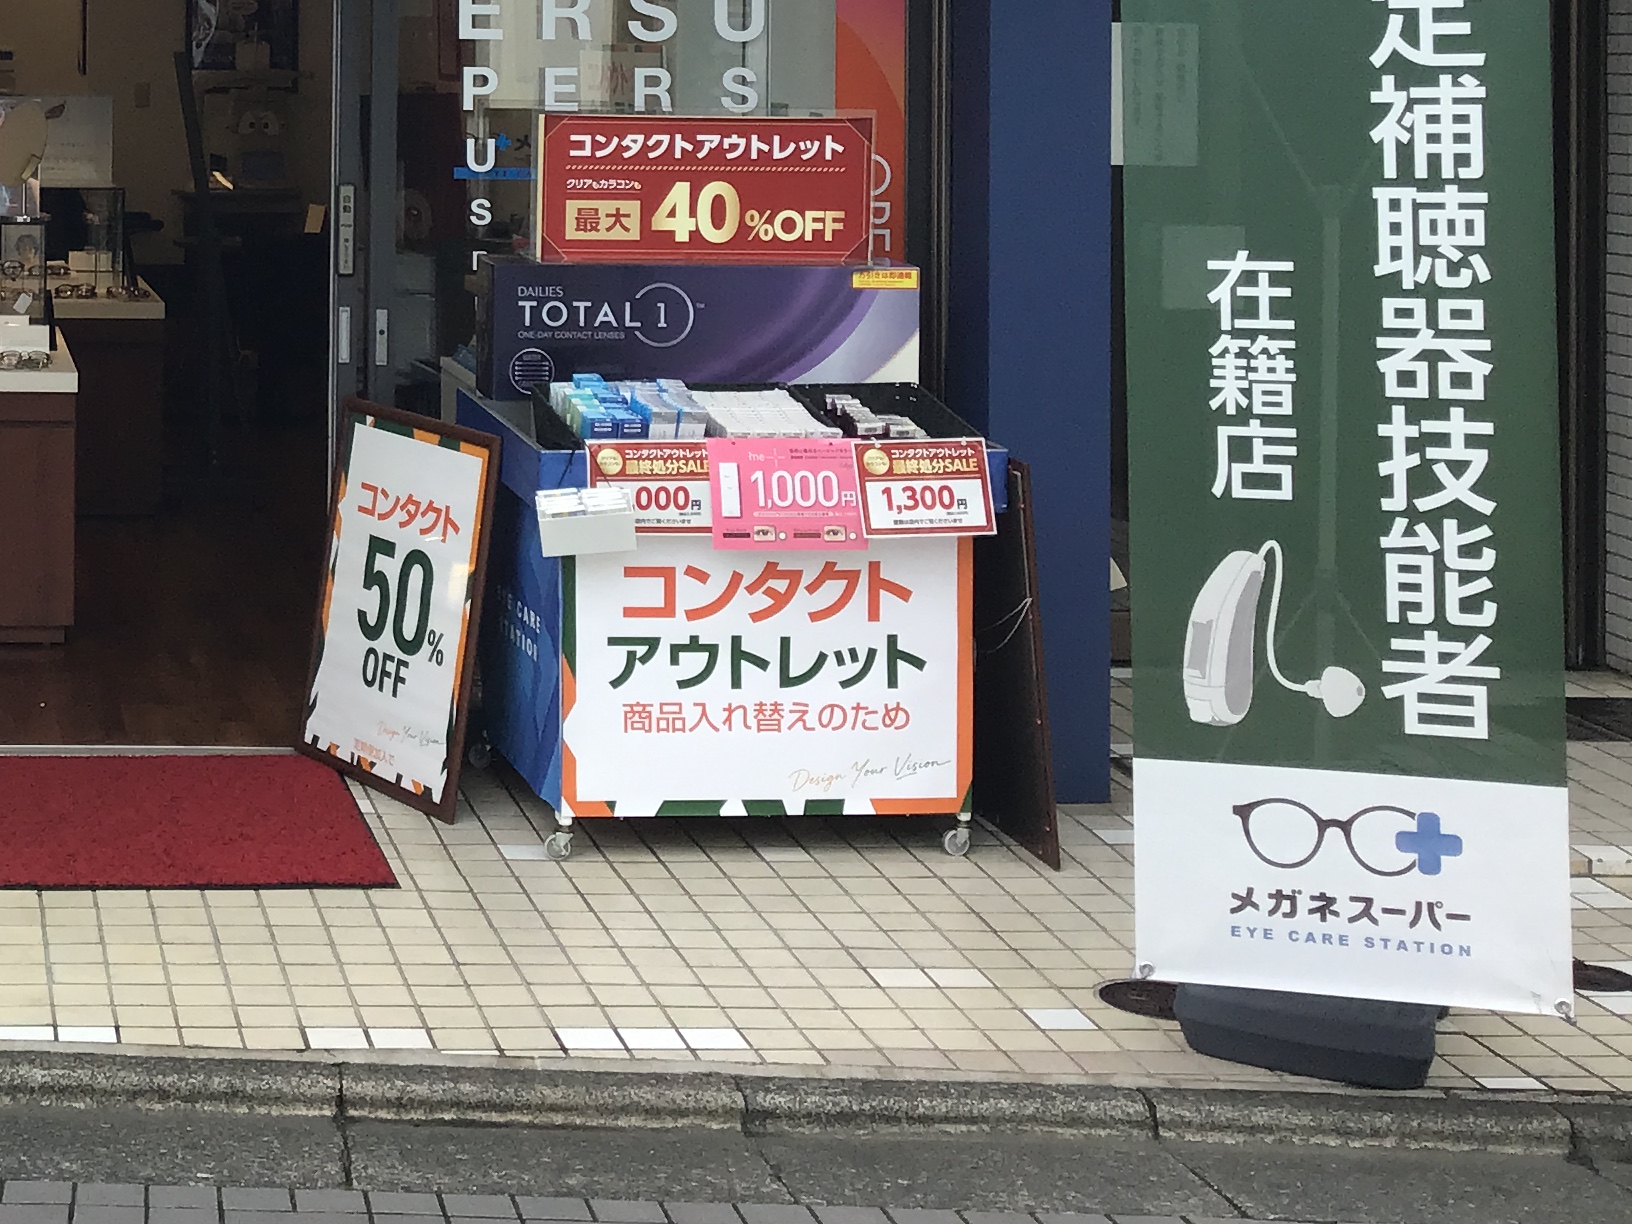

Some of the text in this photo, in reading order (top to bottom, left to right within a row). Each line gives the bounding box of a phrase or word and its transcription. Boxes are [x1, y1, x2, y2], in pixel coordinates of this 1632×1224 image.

[462, 66, 760, 113] PERS
[568, 133, 845, 161] コンタクトアウトレット
[566, 178, 642, 191] クリアもカラコンも
[573, 206, 632, 234] 最大
[517, 286, 564, 297] DAILIES
[517, 300, 641, 328] TOTAL
[554, 331, 592, 340] CONTACT
[594, 331, 626, 340] LENSES
[1206, 250, 1297, 501] 在籍店
[625, 448, 709, 459] コンタクトアウトレット
[891, 447, 976, 459] コンタクトアウトレット
[750, 470, 857, 509] 1,000円
[881, 485, 968, 514] 1,300円
[357, 481, 460, 544] コンタクト
[357, 533, 434, 656] 50
[622, 560, 914, 623] コンタクト
[516, 601, 541, 634] CARE
[427, 631, 444, 666] %
[607, 634, 928, 690] アウトレット
[362, 647, 409, 698] OFF
[622, 700, 911, 734] 商品入れ替えのため
[789, 753, 952, 792] Design Your Vision
[1230, 887, 1471, 931] メガネスーパー
[1231, 925, 1472, 957] EYE CARE STATION
